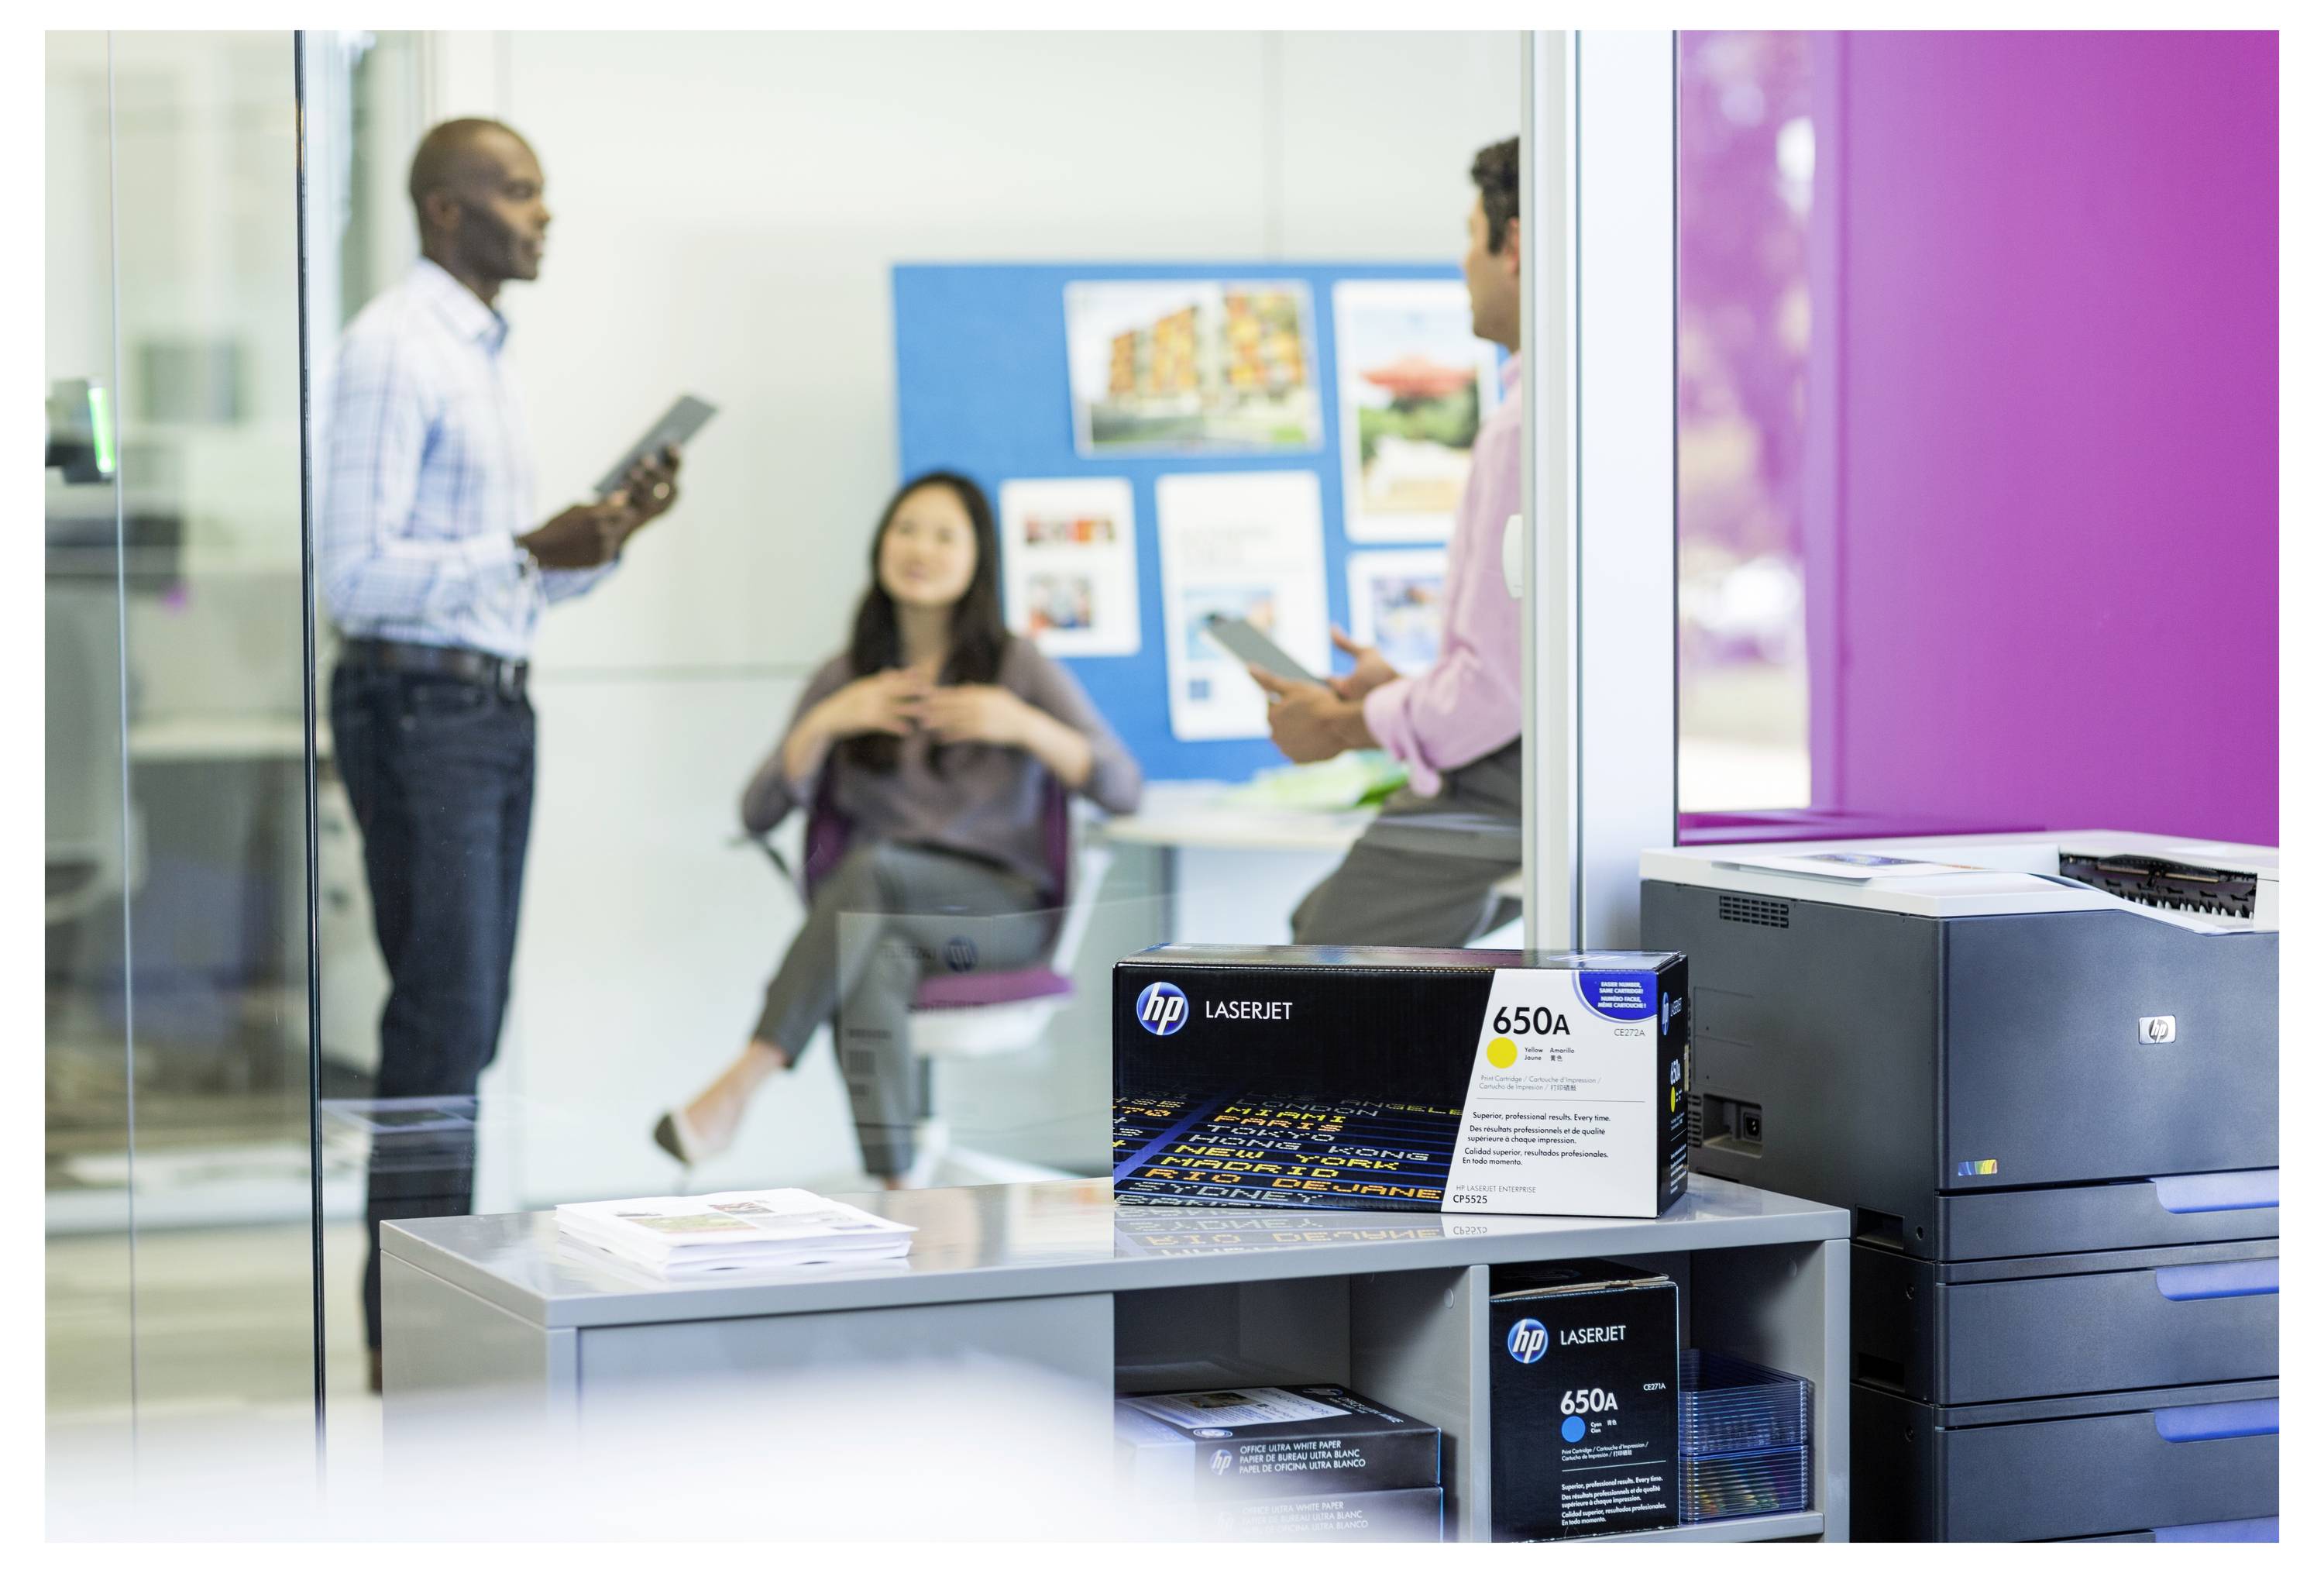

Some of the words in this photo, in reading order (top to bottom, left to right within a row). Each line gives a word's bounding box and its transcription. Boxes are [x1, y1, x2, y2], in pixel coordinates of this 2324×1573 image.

[1142, 982, 1184, 1035] hp
[1205, 1000, 1293, 1020] LASERJET
[1493, 1007, 1570, 1035] 650A
[1614, 1028, 1645, 1037] CE272A
[1225, 1107, 1346, 1123] MIAMI
[1236, 1099, 1378, 1117] LONDON
[1214, 1115, 1343, 1132] PARIS
[1473, 1112, 1504, 1120] Superior,
[1505, 1112, 1547, 1121] professional
[1549, 1113, 1572, 1121] results.
[1574, 1114, 1593, 1123] Every
[1208, 1124, 1335, 1141] TOKYO
[1514, 1126, 1563, 1136] professionnels
[1582, 1127, 1606, 1137] qualité
[1188, 1134, 1302, 1151] HONG
[1329, 1145, 1430, 1162] KONG
[1467, 1135, 1504, 1144] supérieure
[1511, 1136, 1536, 1145] chaque
[1538, 1136, 1577, 1145] impression.
[1174, 1145, 1265, 1158] NEW
[1295, 1154, 1400, 1171] YORK
[1464, 1148, 1491, 1156] Calidad
[1493, 1149, 1523, 1158] superior,
[1561, 1150, 1609, 1160] profesionales.
[1160, 1156, 1339, 1178] MADRID
[1145, 1169, 1241, 1183] RIO
[1129, 1181, 1323, 1203] SYDNEY
[1453, 1195, 1487, 1204] CP5525
[1511, 1319, 1545, 1364] hp
[1560, 1325, 1626, 1346] LASERJET
[1643, 1383, 1666, 1392] CE271A
[1560, 1388, 1618, 1415] 650A
[1240, 1444, 1267, 1454] OFFICE
[1269, 1443, 1291, 1453] ULTRA
[1293, 1441, 1318, 1451] WHITE
[1319, 1440, 1342, 1450] PAPER
[1212, 1449, 1232, 1475] hp
[1239, 1454, 1263, 1465] PAPIER
[1266, 1454, 1276, 1462] DE
[1278, 1452, 1308, 1462] BUREAU
[1310, 1451, 1332, 1461] ULTRA
[1334, 1449, 1360, 1459] BLANC
[1239, 1465, 1261, 1475] PAPEL
[1263, 1464, 1273, 1473] DE
[1274, 1462, 1308, 1472] OFICINA
[1309, 1461, 1332, 1471] ULTRA
[1333, 1458, 1367, 1469] BLANCO
[1562, 1483, 1585, 1492] Superior,
[1586, 1479, 1617, 1490] professional
[1593, 1488, 1630, 1499] professionnels
[1271, 1505, 1294, 1514] ULTRA
[1295, 1503, 1320, 1513] WHITE
[1322, 1502, 1344, 1511] PAPER
[1613, 1496, 1642, 1504] impression.
[1313, 1512, 1336, 1522] ULTRA
[1337, 1510, 1363, 1520] BLANC
[1562, 1510, 1582, 1519] Calidad
[1583, 1509, 1605, 1517] superior,
[1631, 1502, 1667, 1513] profesionales.
[1312, 1522, 1334, 1531] ULTRA
[1336, 1520, 1369, 1530] BLANCO
